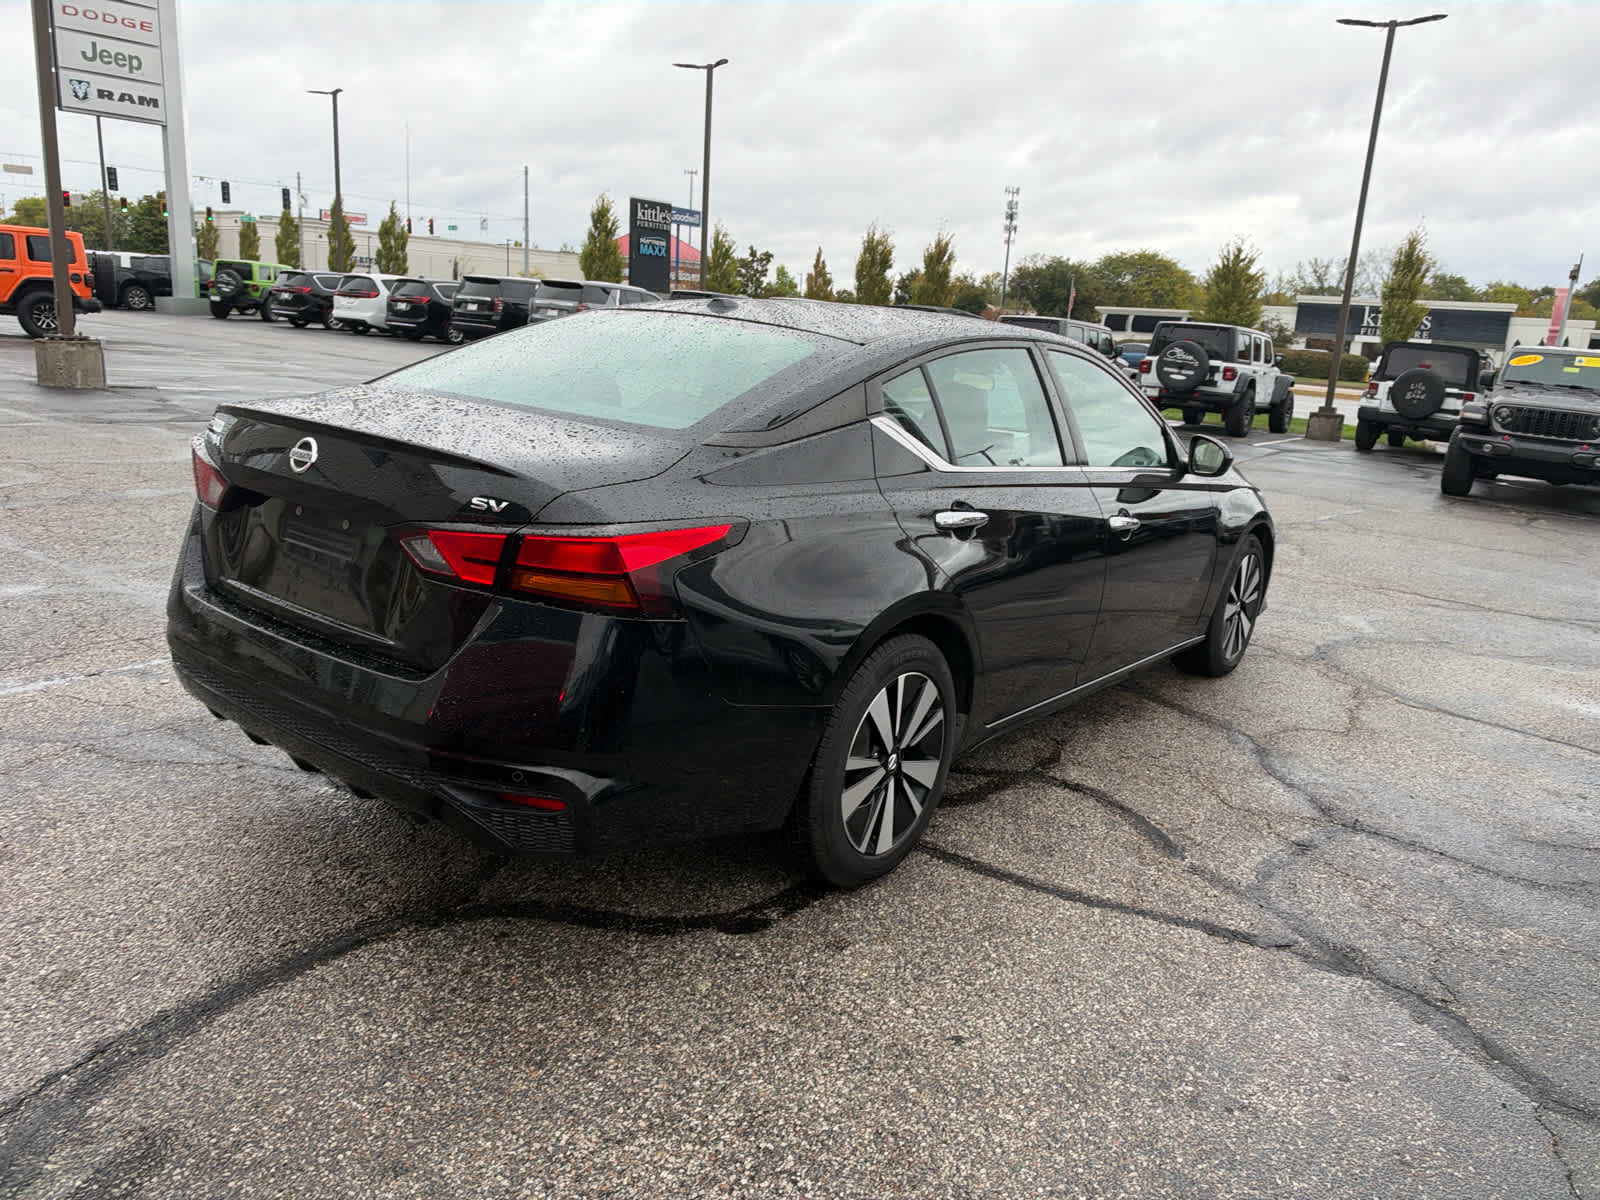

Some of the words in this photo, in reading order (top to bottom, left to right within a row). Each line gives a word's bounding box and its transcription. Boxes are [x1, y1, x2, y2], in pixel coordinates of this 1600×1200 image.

[62, 5, 153, 33] DODGE
[80, 41, 142, 74] Jeep
[96, 88, 160, 109] RAM
[636, 203, 672, 223] kittle's
[640, 244, 666, 257] MAXX
[469, 496, 510, 513] SV
